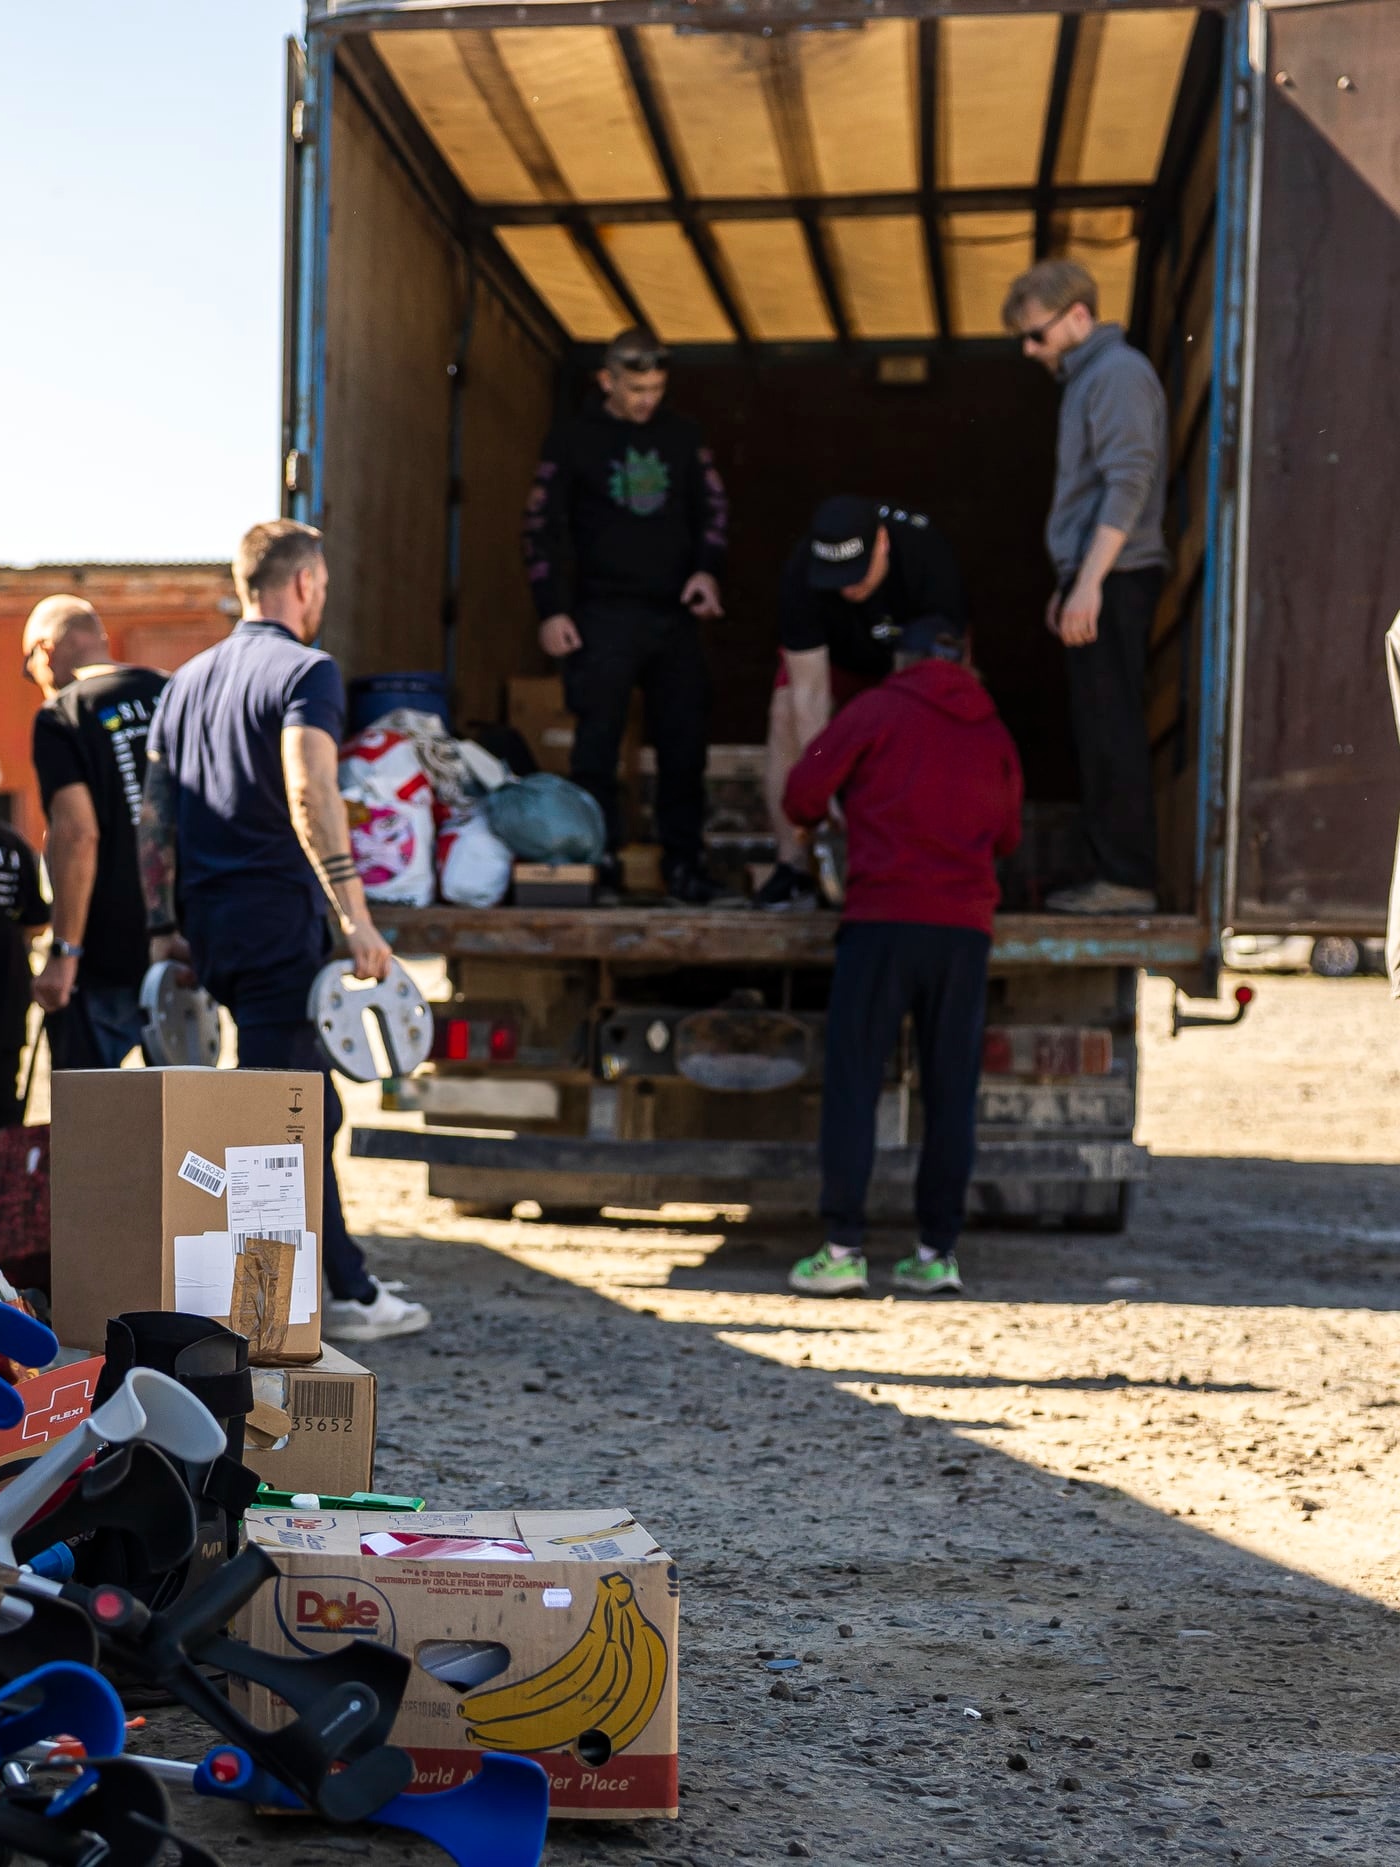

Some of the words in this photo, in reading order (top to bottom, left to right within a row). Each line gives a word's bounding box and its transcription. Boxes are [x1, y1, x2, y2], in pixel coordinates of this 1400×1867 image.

[49, 1407, 84, 1423] FLEXI
[291, 1417, 353, 1433] 35652
[446, 1570, 461, 1578] Dole
[462, 1571, 480, 1579] Food
[374, 1576, 421, 1586] DISTRIBUTED
[422, 1577, 433, 1586] BY
[433, 1578, 457, 1587] DOLE
[457, 1579, 485, 1588] FRESH
[486, 1580, 511, 1588] FRUIT
[512, 1580, 556, 1589] COMPANY
[426, 1587, 471, 1596] CHARLOTTE,
[471, 1588, 484, 1597] NC
